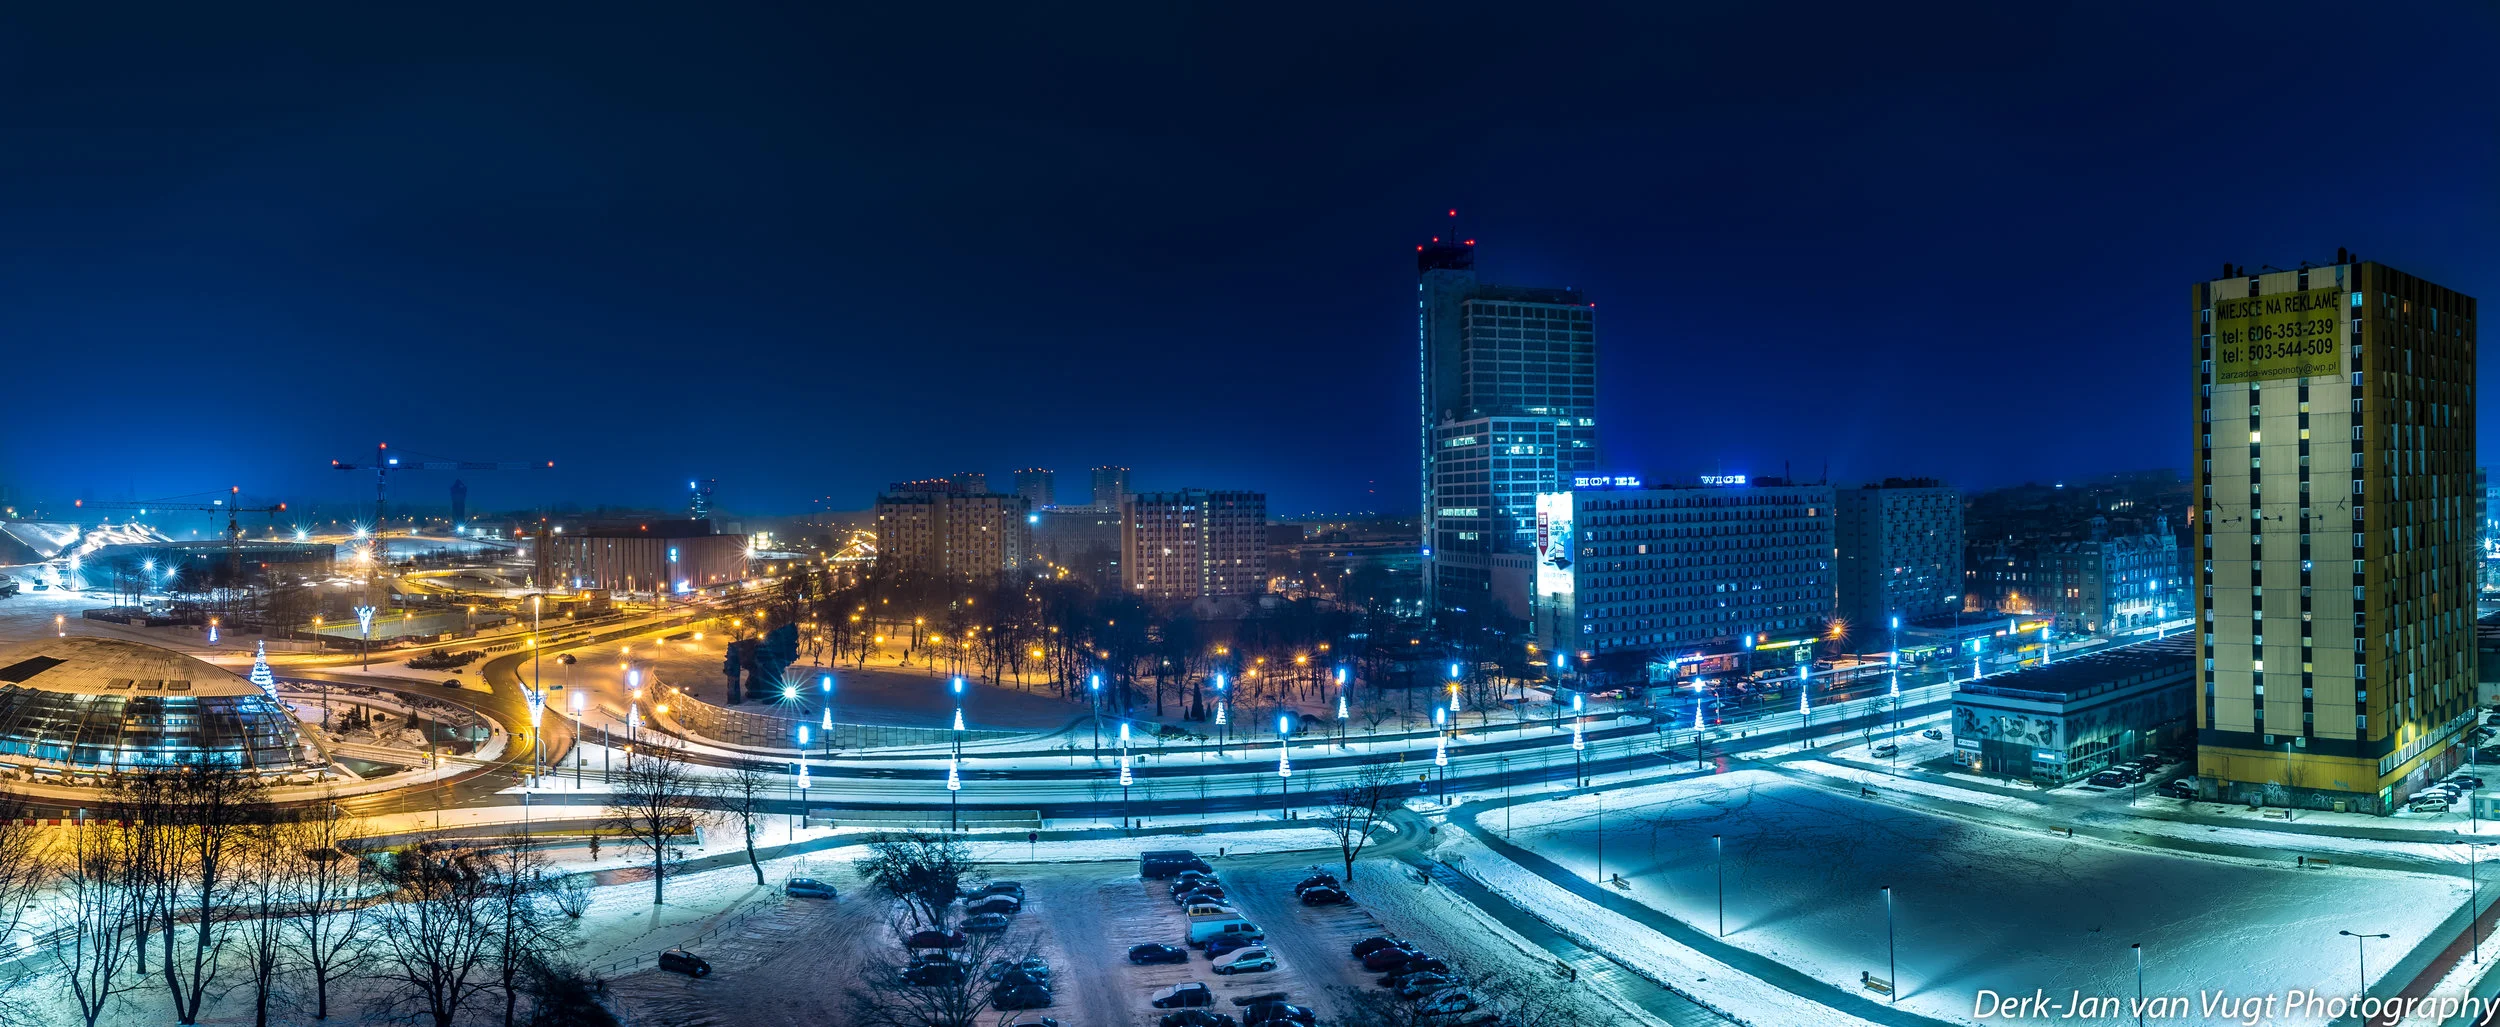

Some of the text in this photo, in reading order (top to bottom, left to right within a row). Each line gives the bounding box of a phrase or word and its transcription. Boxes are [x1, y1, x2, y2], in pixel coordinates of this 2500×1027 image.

[2217, 291, 2339, 320] MIEJSCE NA REKLAMĘ
[2222, 318, 2334, 344] tel: 606-353-239
[2223, 338, 2333, 363] tel: 503-544-509
